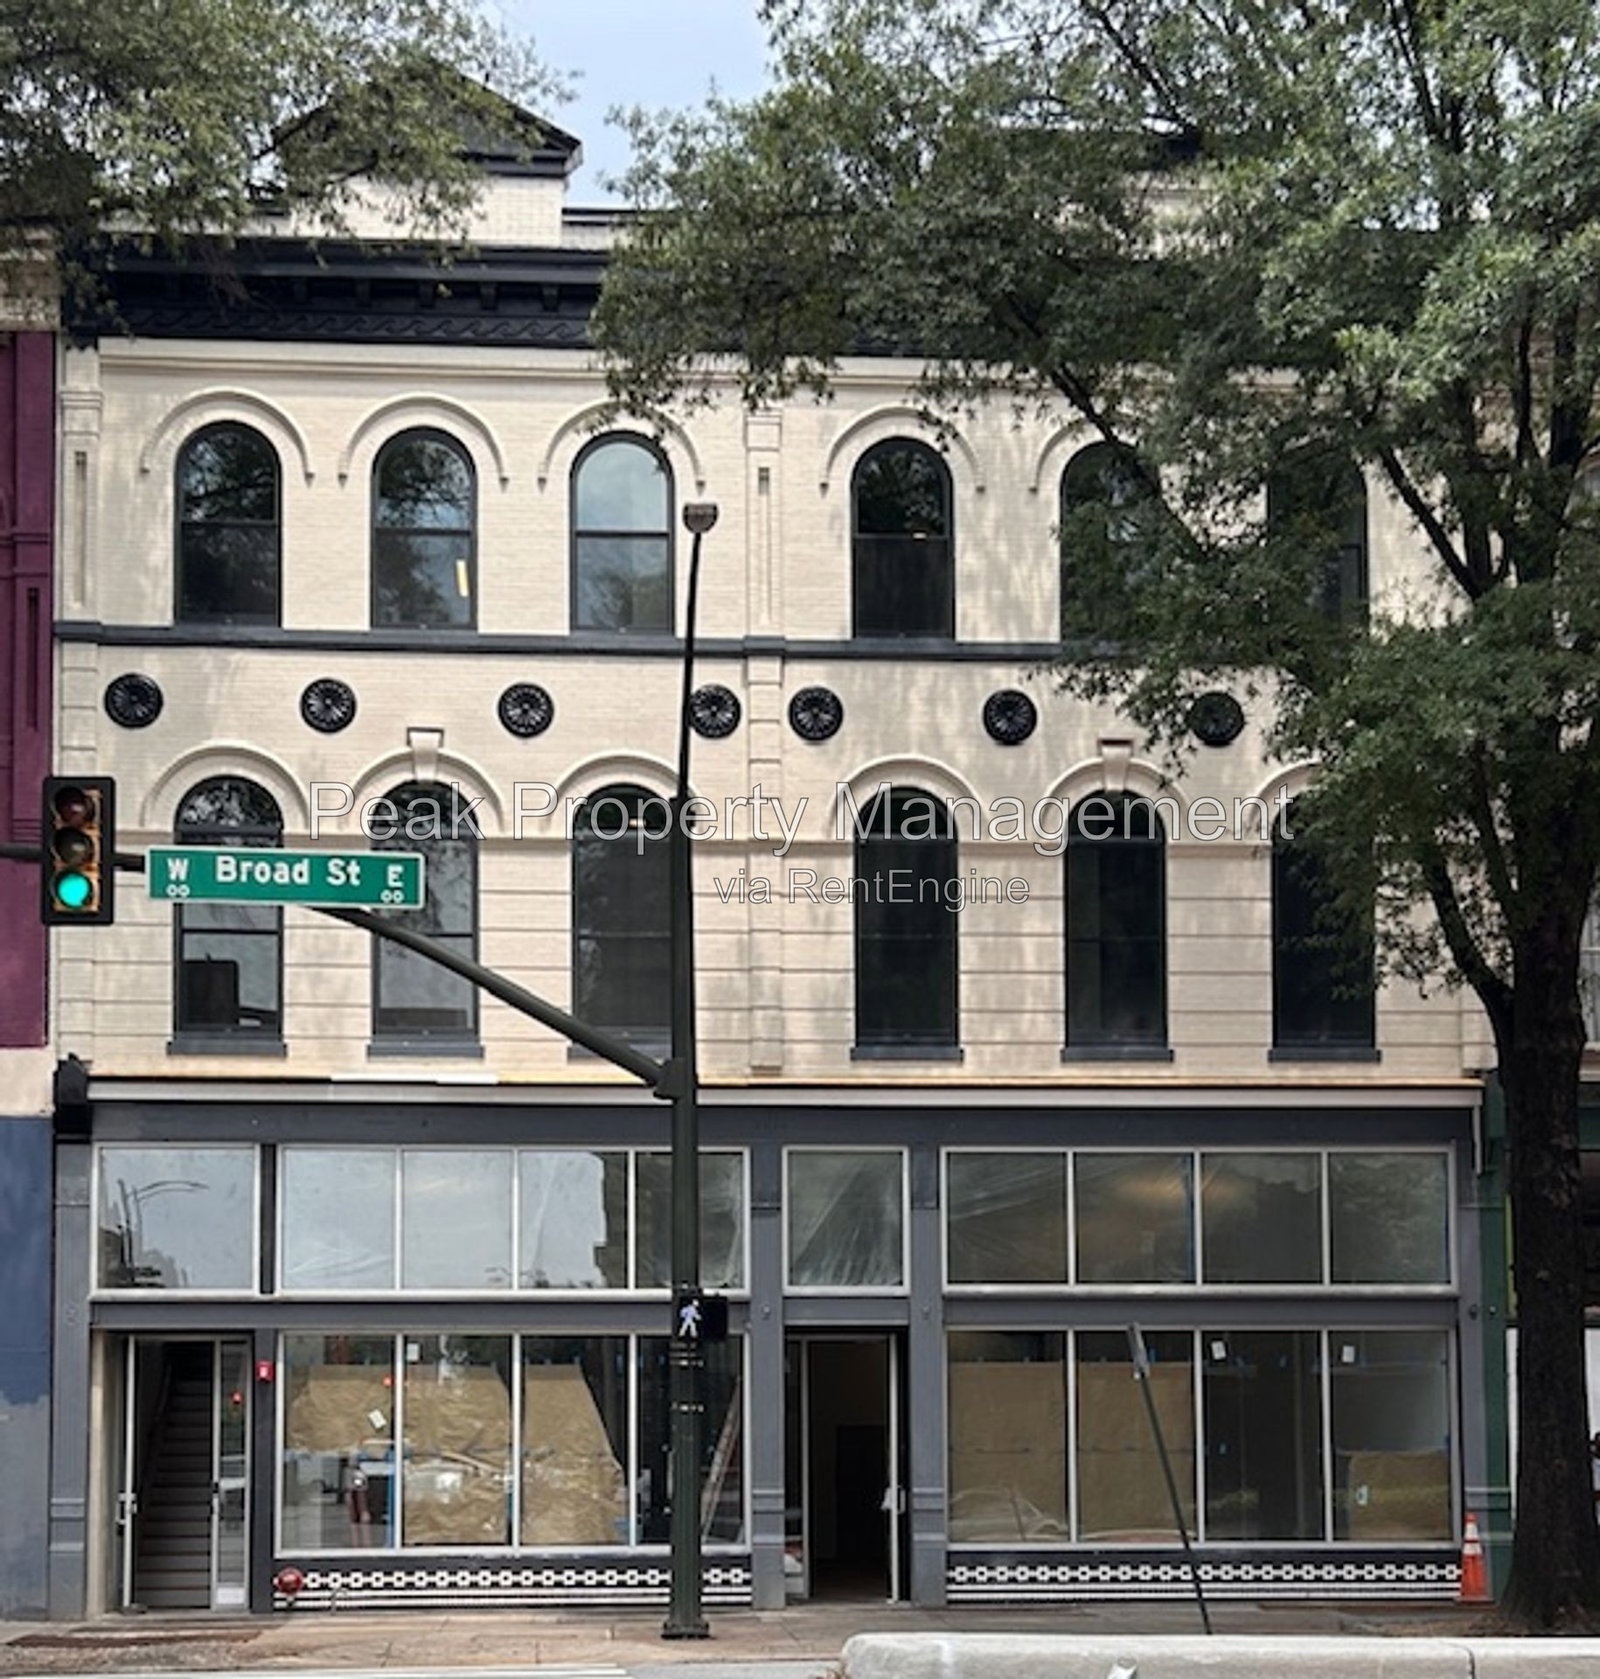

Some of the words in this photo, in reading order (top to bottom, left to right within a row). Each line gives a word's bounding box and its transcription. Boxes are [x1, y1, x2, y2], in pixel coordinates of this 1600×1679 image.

[167, 857, 189, 881] W
[216, 855, 310, 884] Broad
[326, 858, 360, 886] St
[387, 865, 404, 888] E
